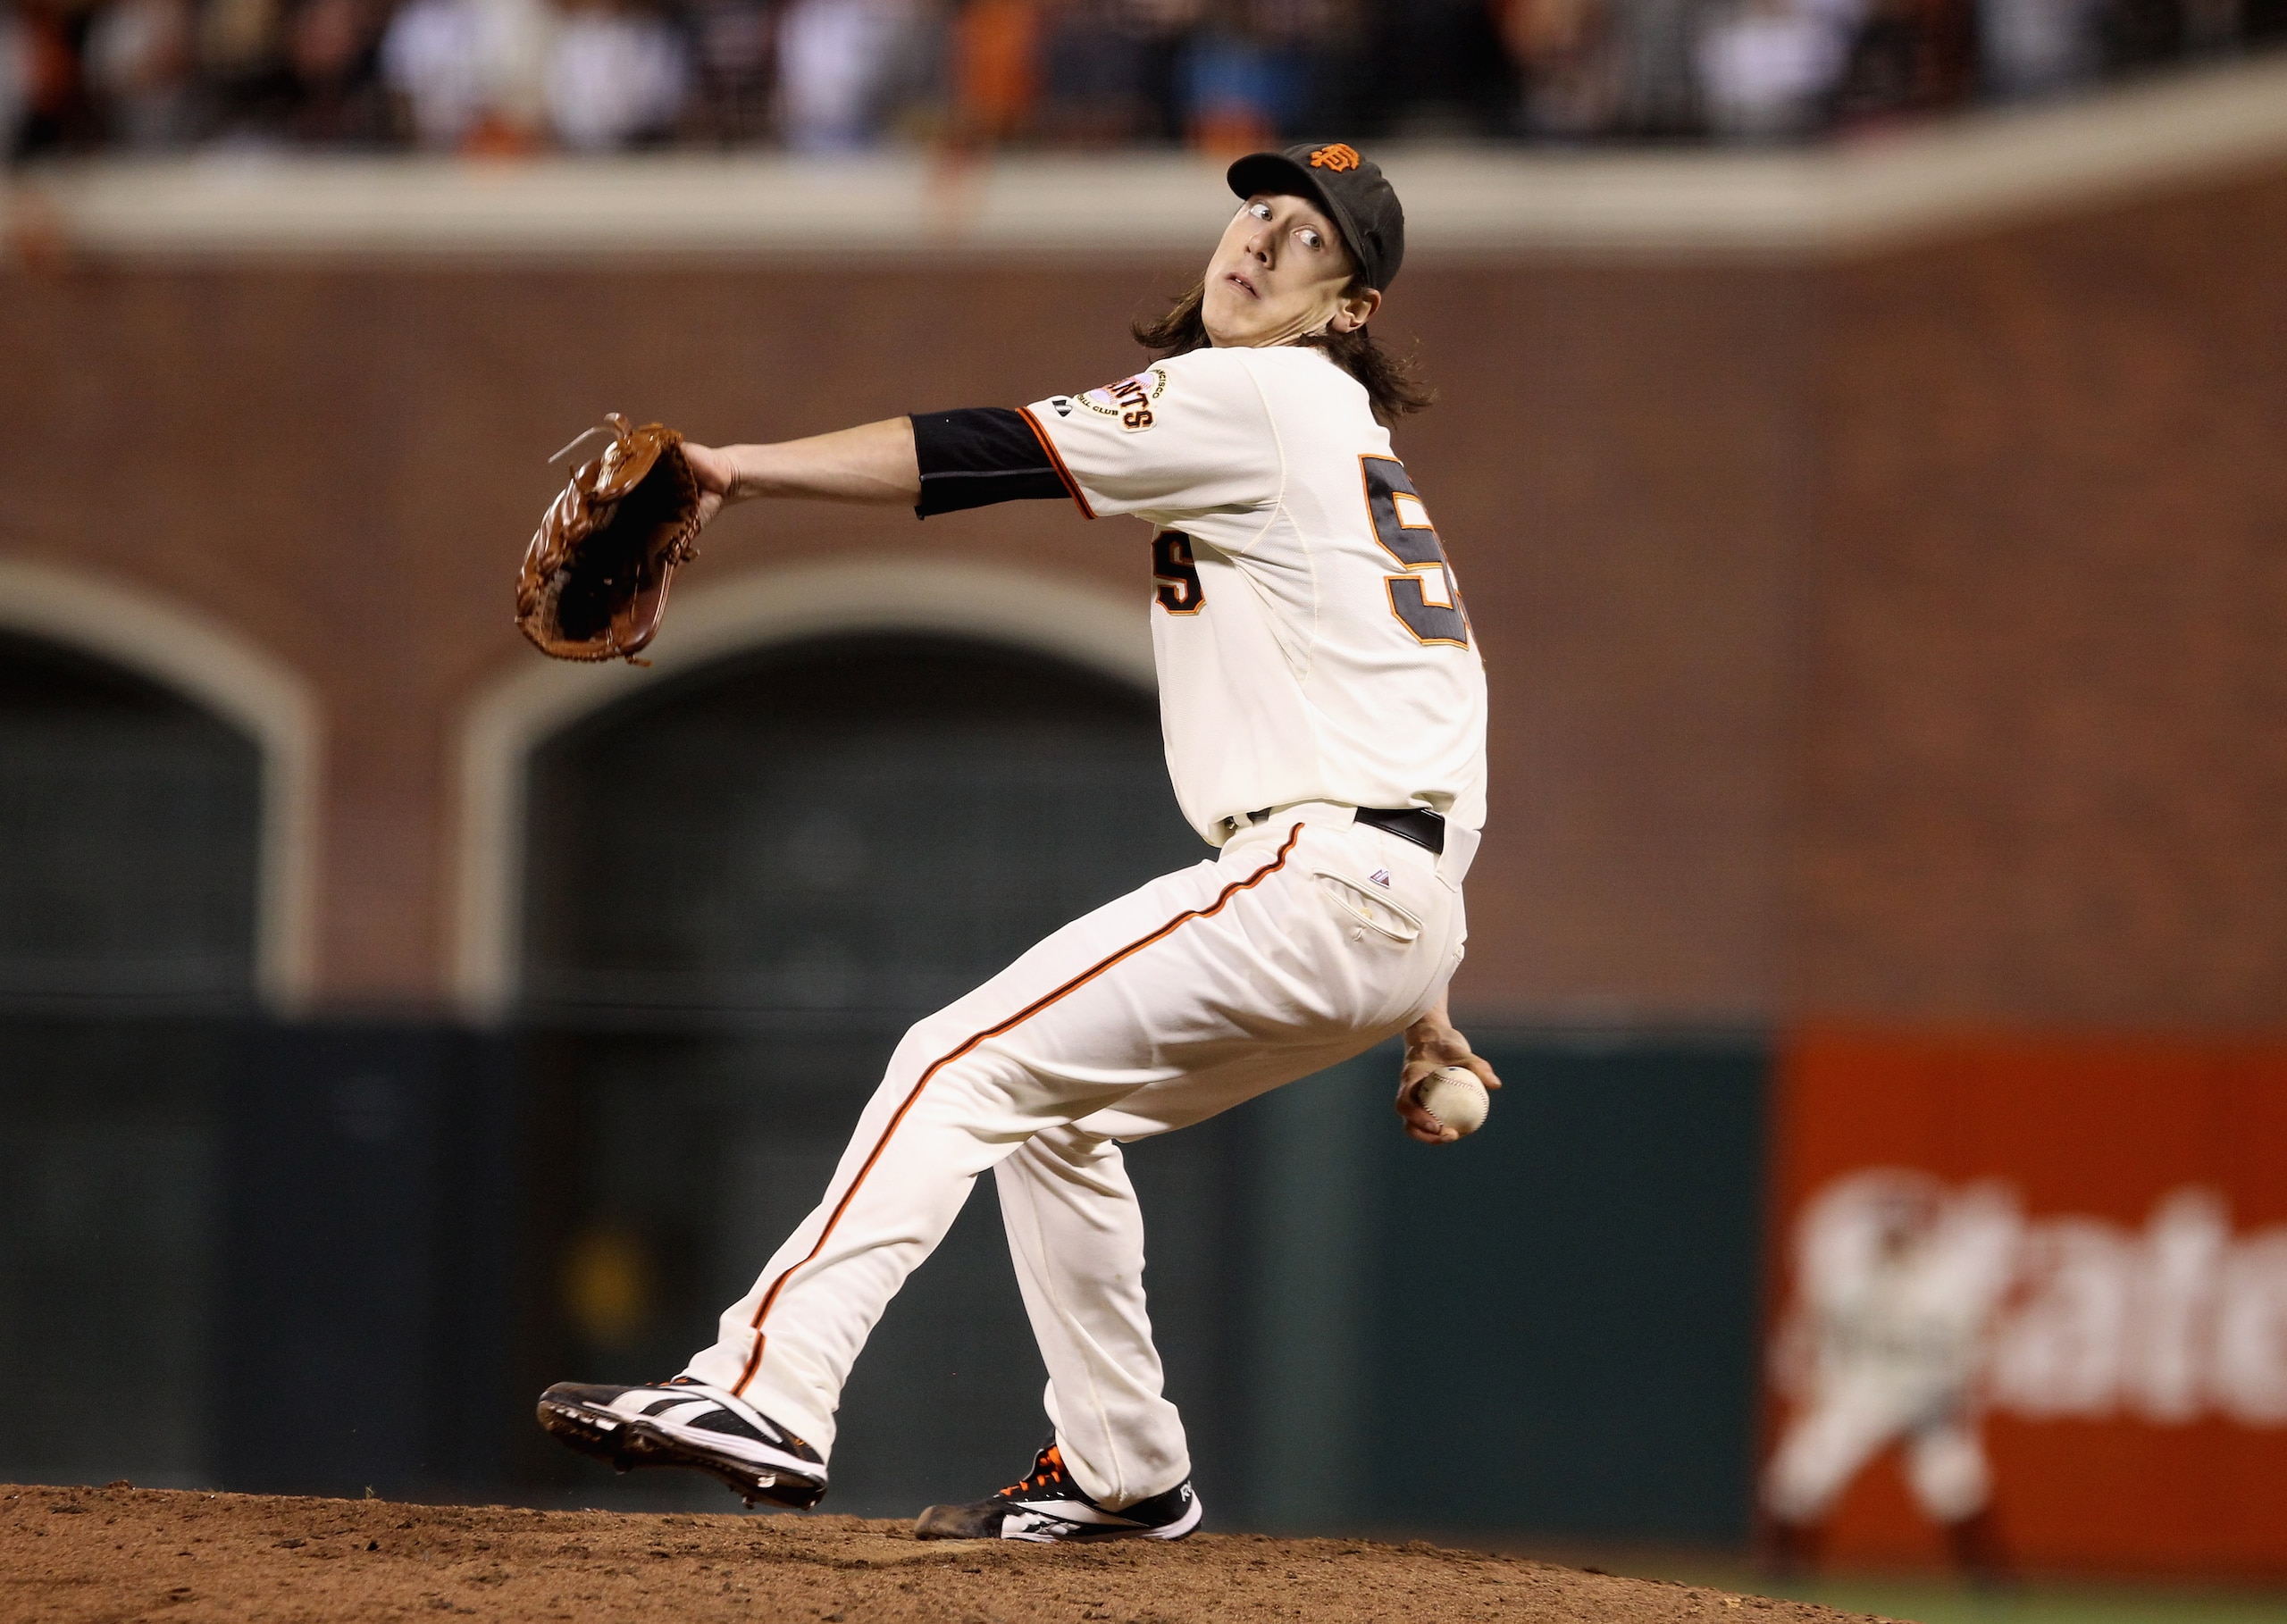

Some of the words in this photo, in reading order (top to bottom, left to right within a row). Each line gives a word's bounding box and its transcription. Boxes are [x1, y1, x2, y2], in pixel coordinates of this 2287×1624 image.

[1107, 381, 1153, 429] NTS
[1151, 369, 1167, 398] NCISCO
[1093, 406, 1118, 416] CLUB
[1152, 530, 1207, 615] S
[1357, 453, 1474, 650] 5
